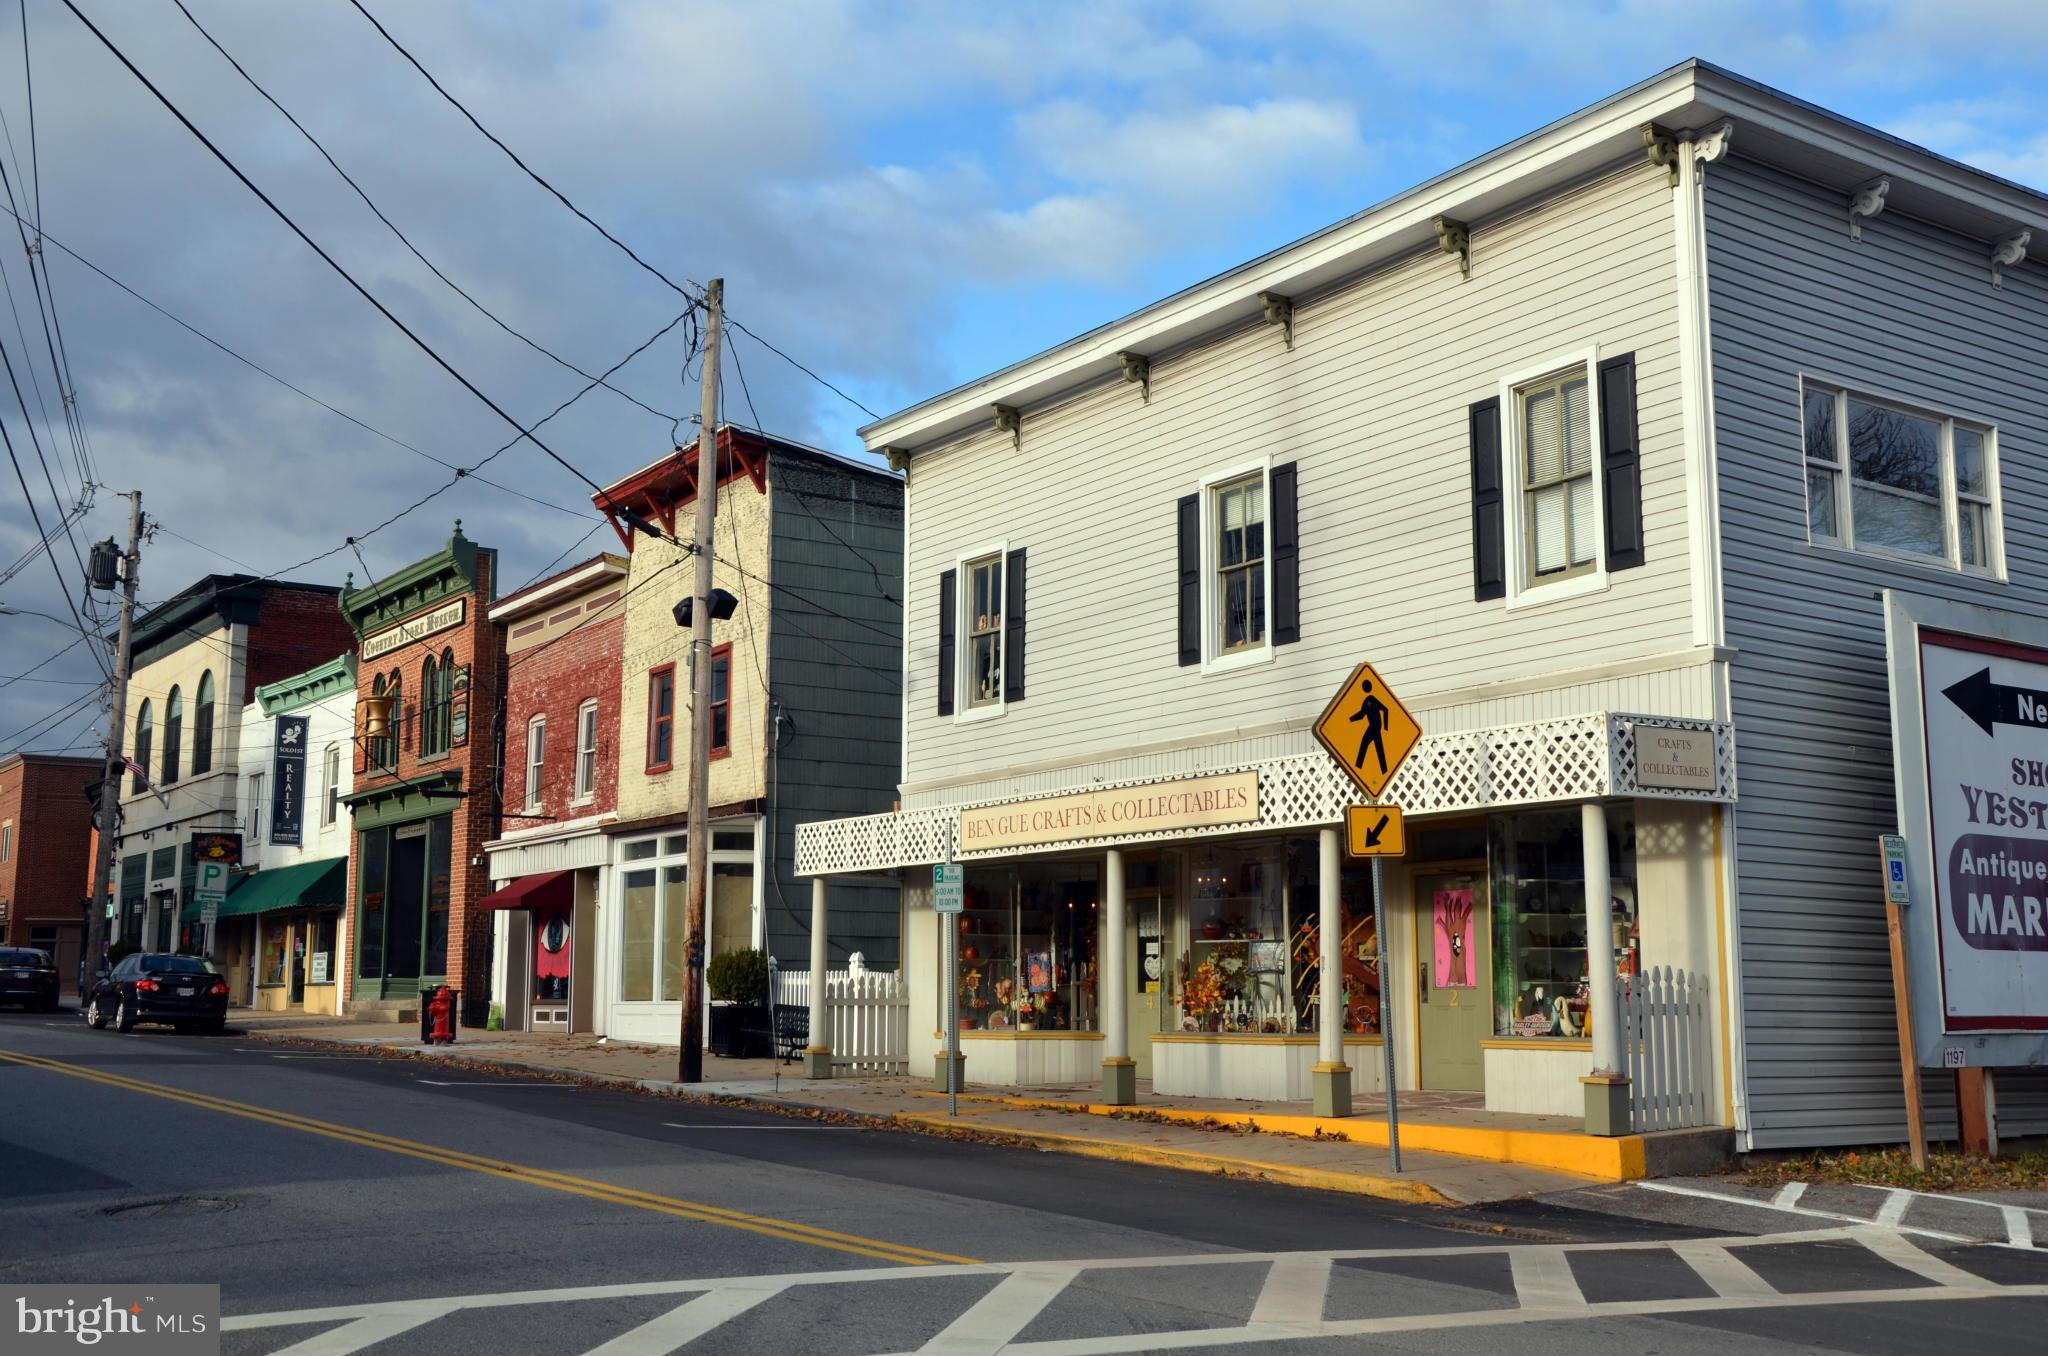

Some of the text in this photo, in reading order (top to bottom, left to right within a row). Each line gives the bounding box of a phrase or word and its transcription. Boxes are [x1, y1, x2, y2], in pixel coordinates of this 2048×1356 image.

[1657, 737, 1692, 750] CRAFTS
[1672, 752, 1679, 761] &
[1642, 763, 1710, 777] COLLECTABLES
[2011, 757, 2048, 788] SH
[967, 786, 1248, 839] BEN GUE CRAFTS & COLLECTABLES
[203, 865, 221, 888] P
[935, 868, 943, 881] 2
[1960, 848, 2048, 886] Antique
[1967, 893, 2048, 937] MAR
[1450, 988, 1459, 1008] 2
[1946, 1050, 1965, 1065] 1197
